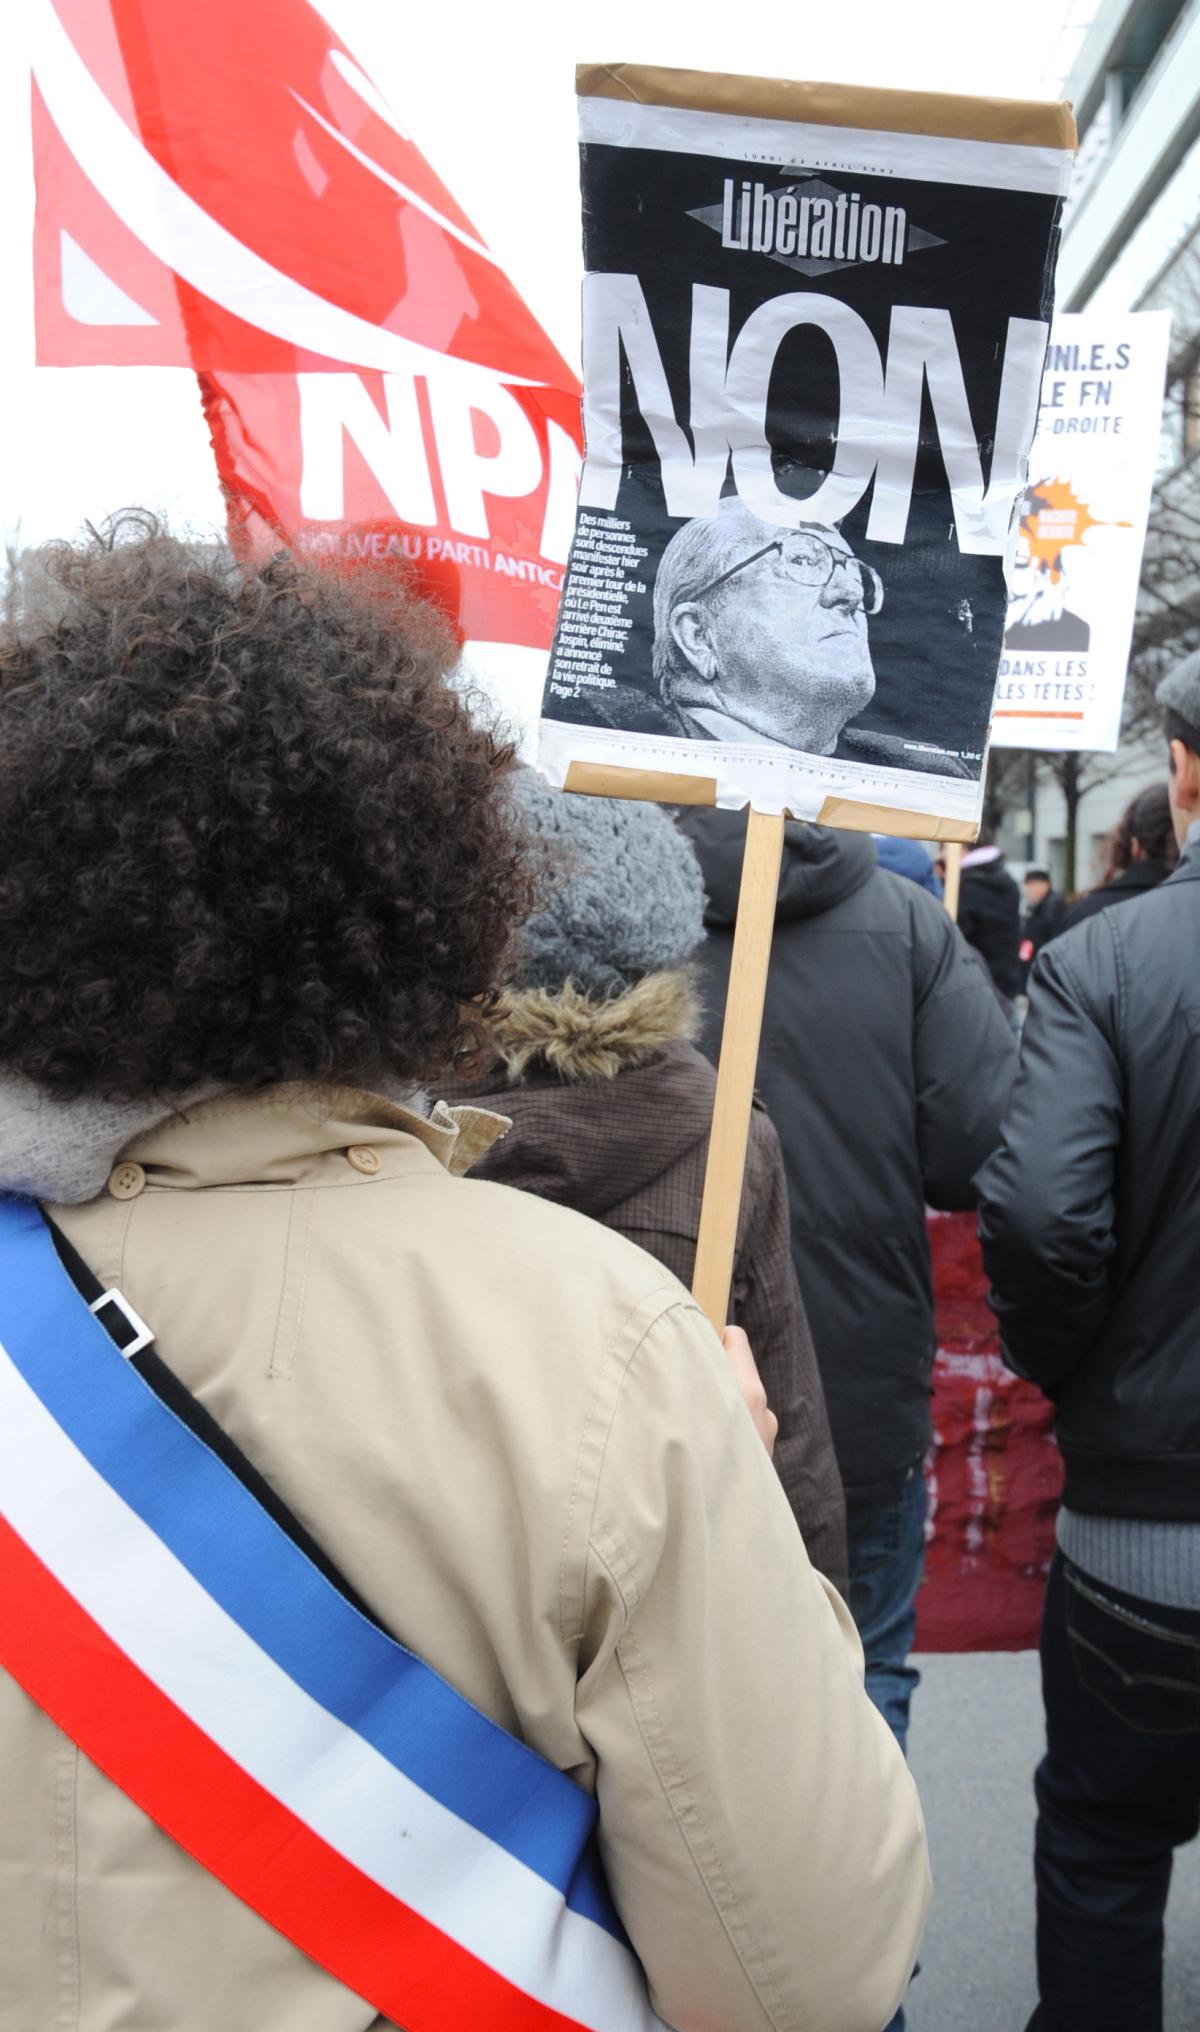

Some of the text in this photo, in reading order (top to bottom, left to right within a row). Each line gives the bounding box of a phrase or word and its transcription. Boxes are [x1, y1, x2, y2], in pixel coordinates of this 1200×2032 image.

[744, 152, 782, 161] LUNDI
[815, 160, 853, 170] AVRIL
[722, 178, 906, 265] Libération
[1079, 380, 1112, 406] FN
[577, 272, 1049, 556] NON
[580, 513, 631, 531] Des milliers
[578, 525, 636, 543] de personnes
[575, 538, 649, 557] sont descendues
[426, 535, 491, 572] PARTI
[494, 552, 566, 592] ANTIC
[573, 550, 641, 568] manifester hier
[571, 561, 625, 579] soir après le
[568, 574, 647, 594] premier tour de la
[566, 586, 629, 604] présidentielle,
[565, 597, 622, 615] où Le Pen est
[562, 609, 633, 629] arrivé deuxième
[560, 621, 629, 641] derrière Chirac.
[559, 633, 625, 654] Jospin, éliminé,
[556, 647, 603, 662] a annoncé
[554, 659, 613, 675] son retrait de
[1000, 660, 1087, 677] DANS LES
[552, 668, 617, 690] la vie politique.
[550, 682, 581, 699] Page 2
[997, 683, 1026, 700] LES
